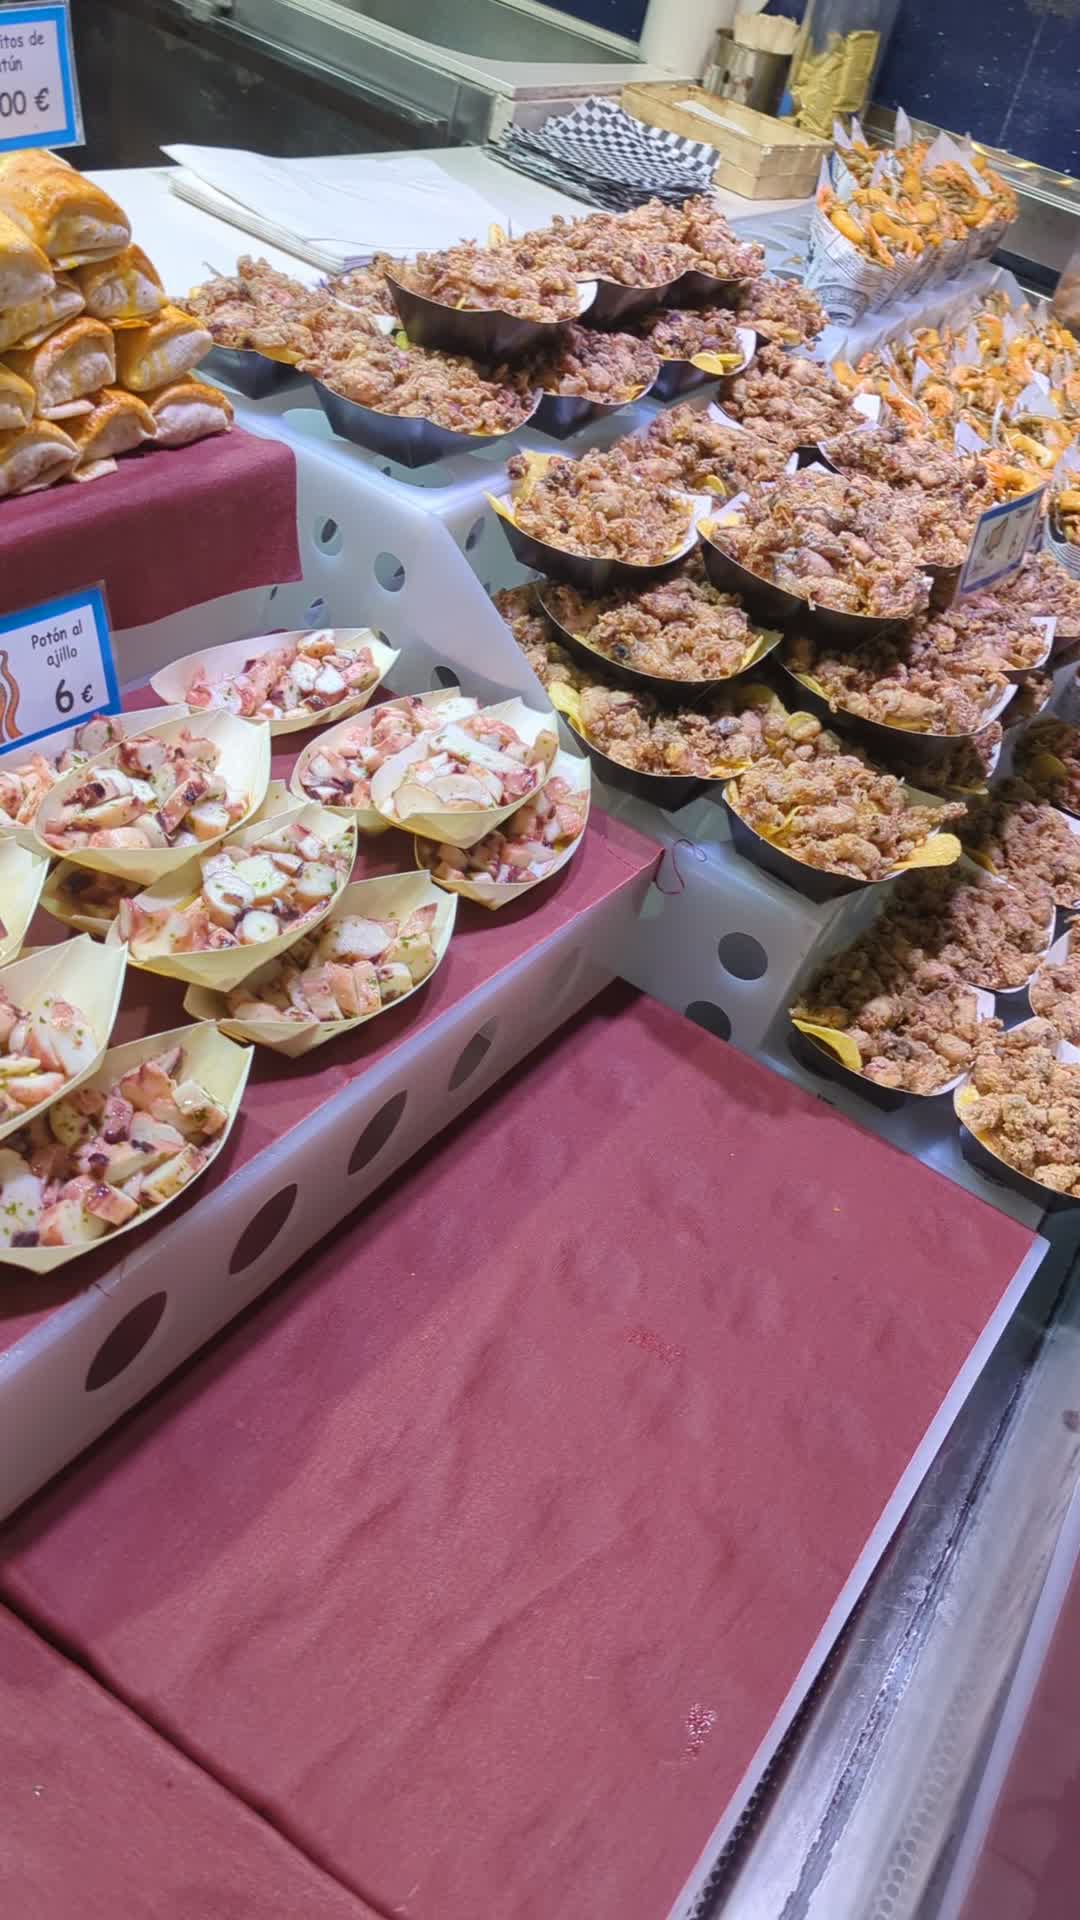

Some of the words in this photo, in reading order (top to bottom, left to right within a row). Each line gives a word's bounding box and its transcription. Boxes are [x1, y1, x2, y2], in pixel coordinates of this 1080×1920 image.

[28, 29, 45, 46] de
[0, 55, 23, 72] tún
[34, 87, 50, 112] €
[31, 627, 68, 650] Potón
[72, 620, 83, 636] al
[47, 645, 78, 668] ajillo
[55, 679, 74, 713] 6
[81, 684, 94, 703] €
